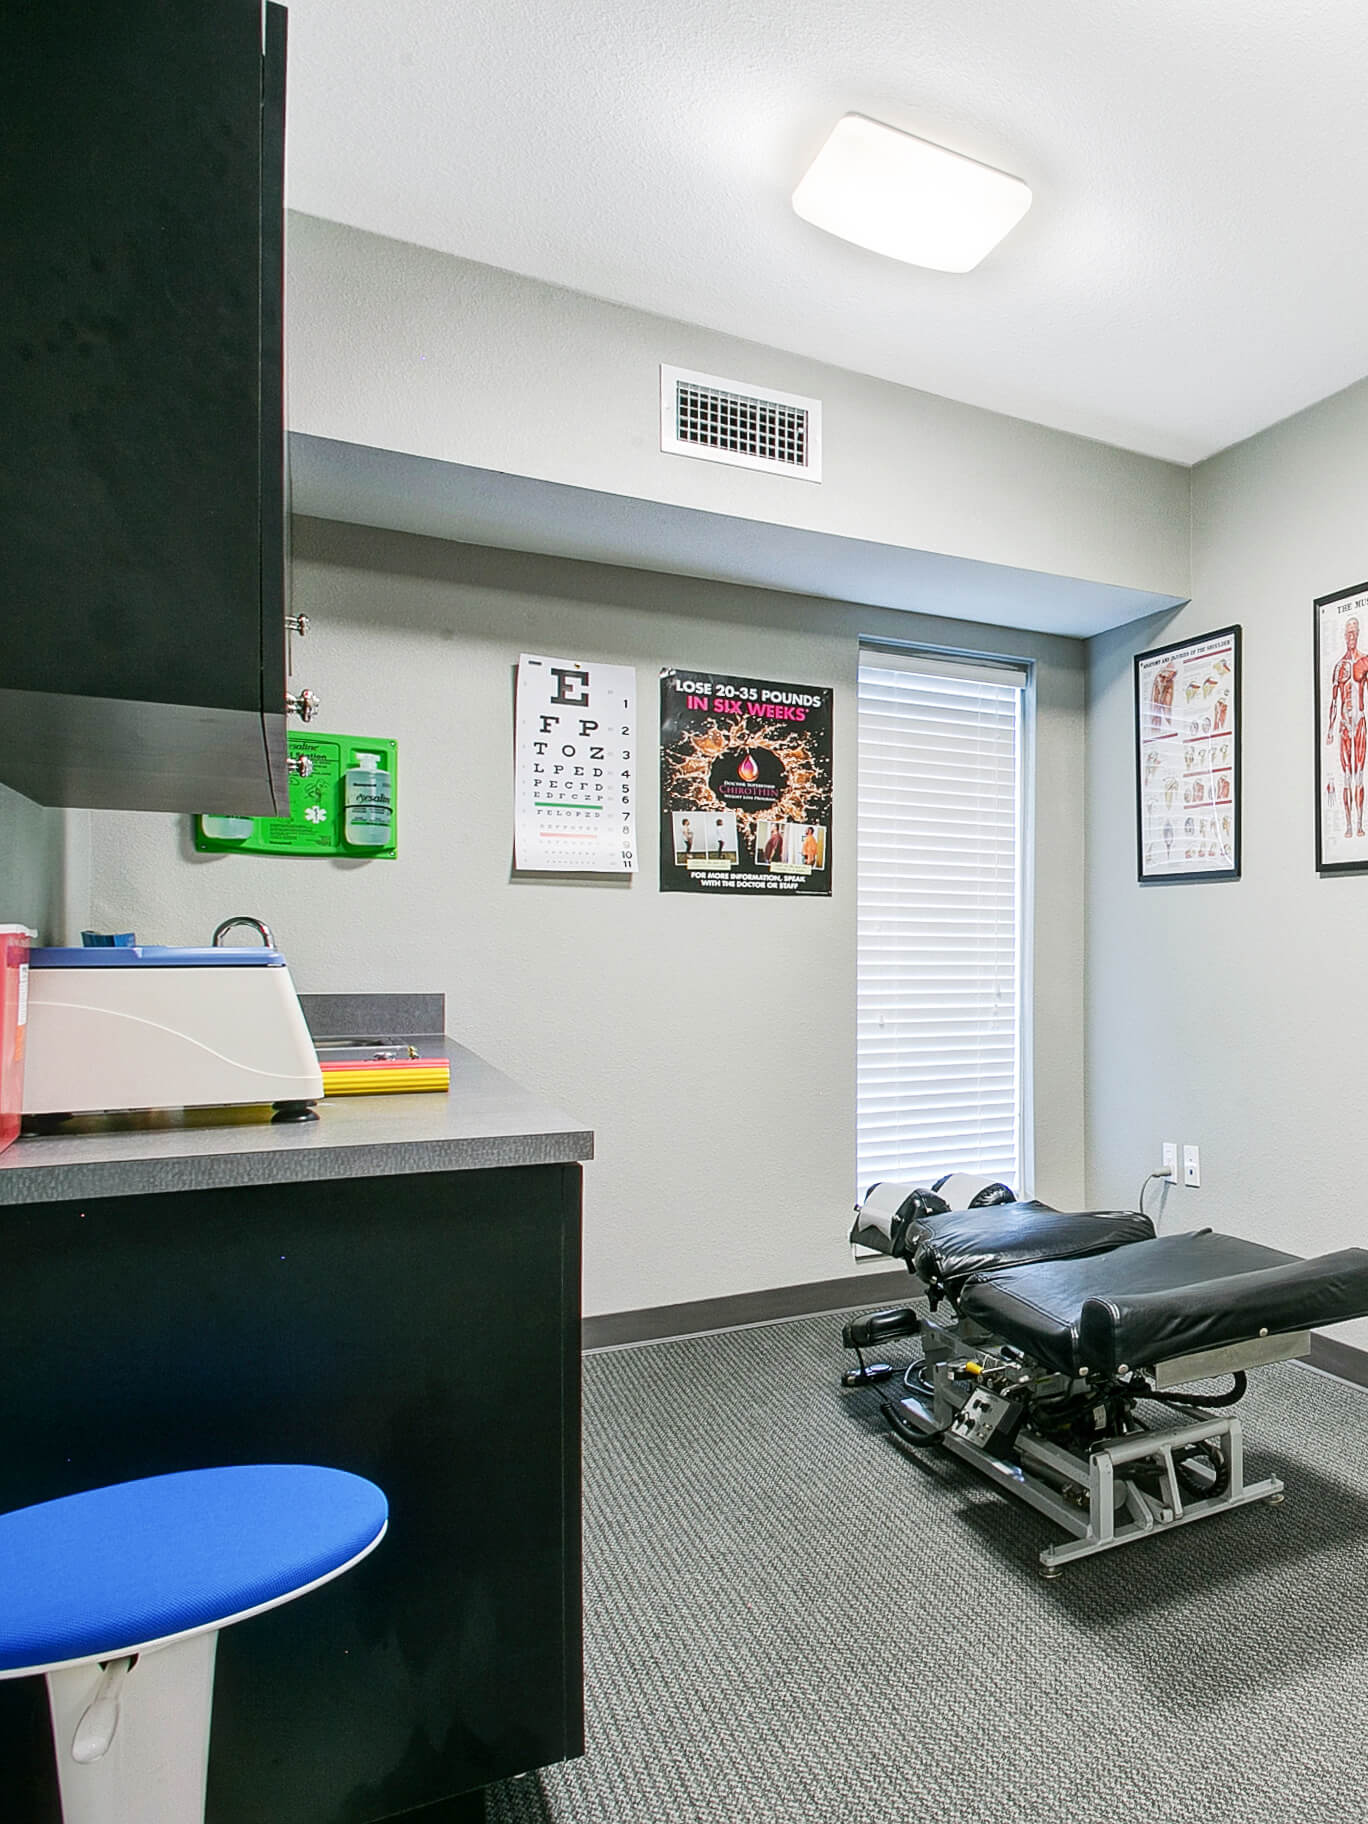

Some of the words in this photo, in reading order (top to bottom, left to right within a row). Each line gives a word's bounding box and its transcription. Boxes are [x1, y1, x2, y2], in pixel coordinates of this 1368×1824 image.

[1337, 602, 1352, 614] THE
[550, 668, 589, 707] E
[675, 679, 712, 695] LOSE
[715, 685, 758, 700] 20-35
[761, 690, 821, 708] POUNDS
[623, 699, 628, 709] 1
[686, 695, 709, 712] IN
[713, 698, 743, 715] SIX
[621, 726, 630, 736] 2
[622, 750, 631, 760] 3
[621, 769, 631, 779] 4
[621, 784, 630, 794] 5
[621, 795, 630, 805] 6
[622, 812, 631, 821] 7
[622, 825, 630, 835] 8
[622, 850, 633, 860] 10
[623, 860, 632, 868] 11
[690, 871, 706, 879] FOR
